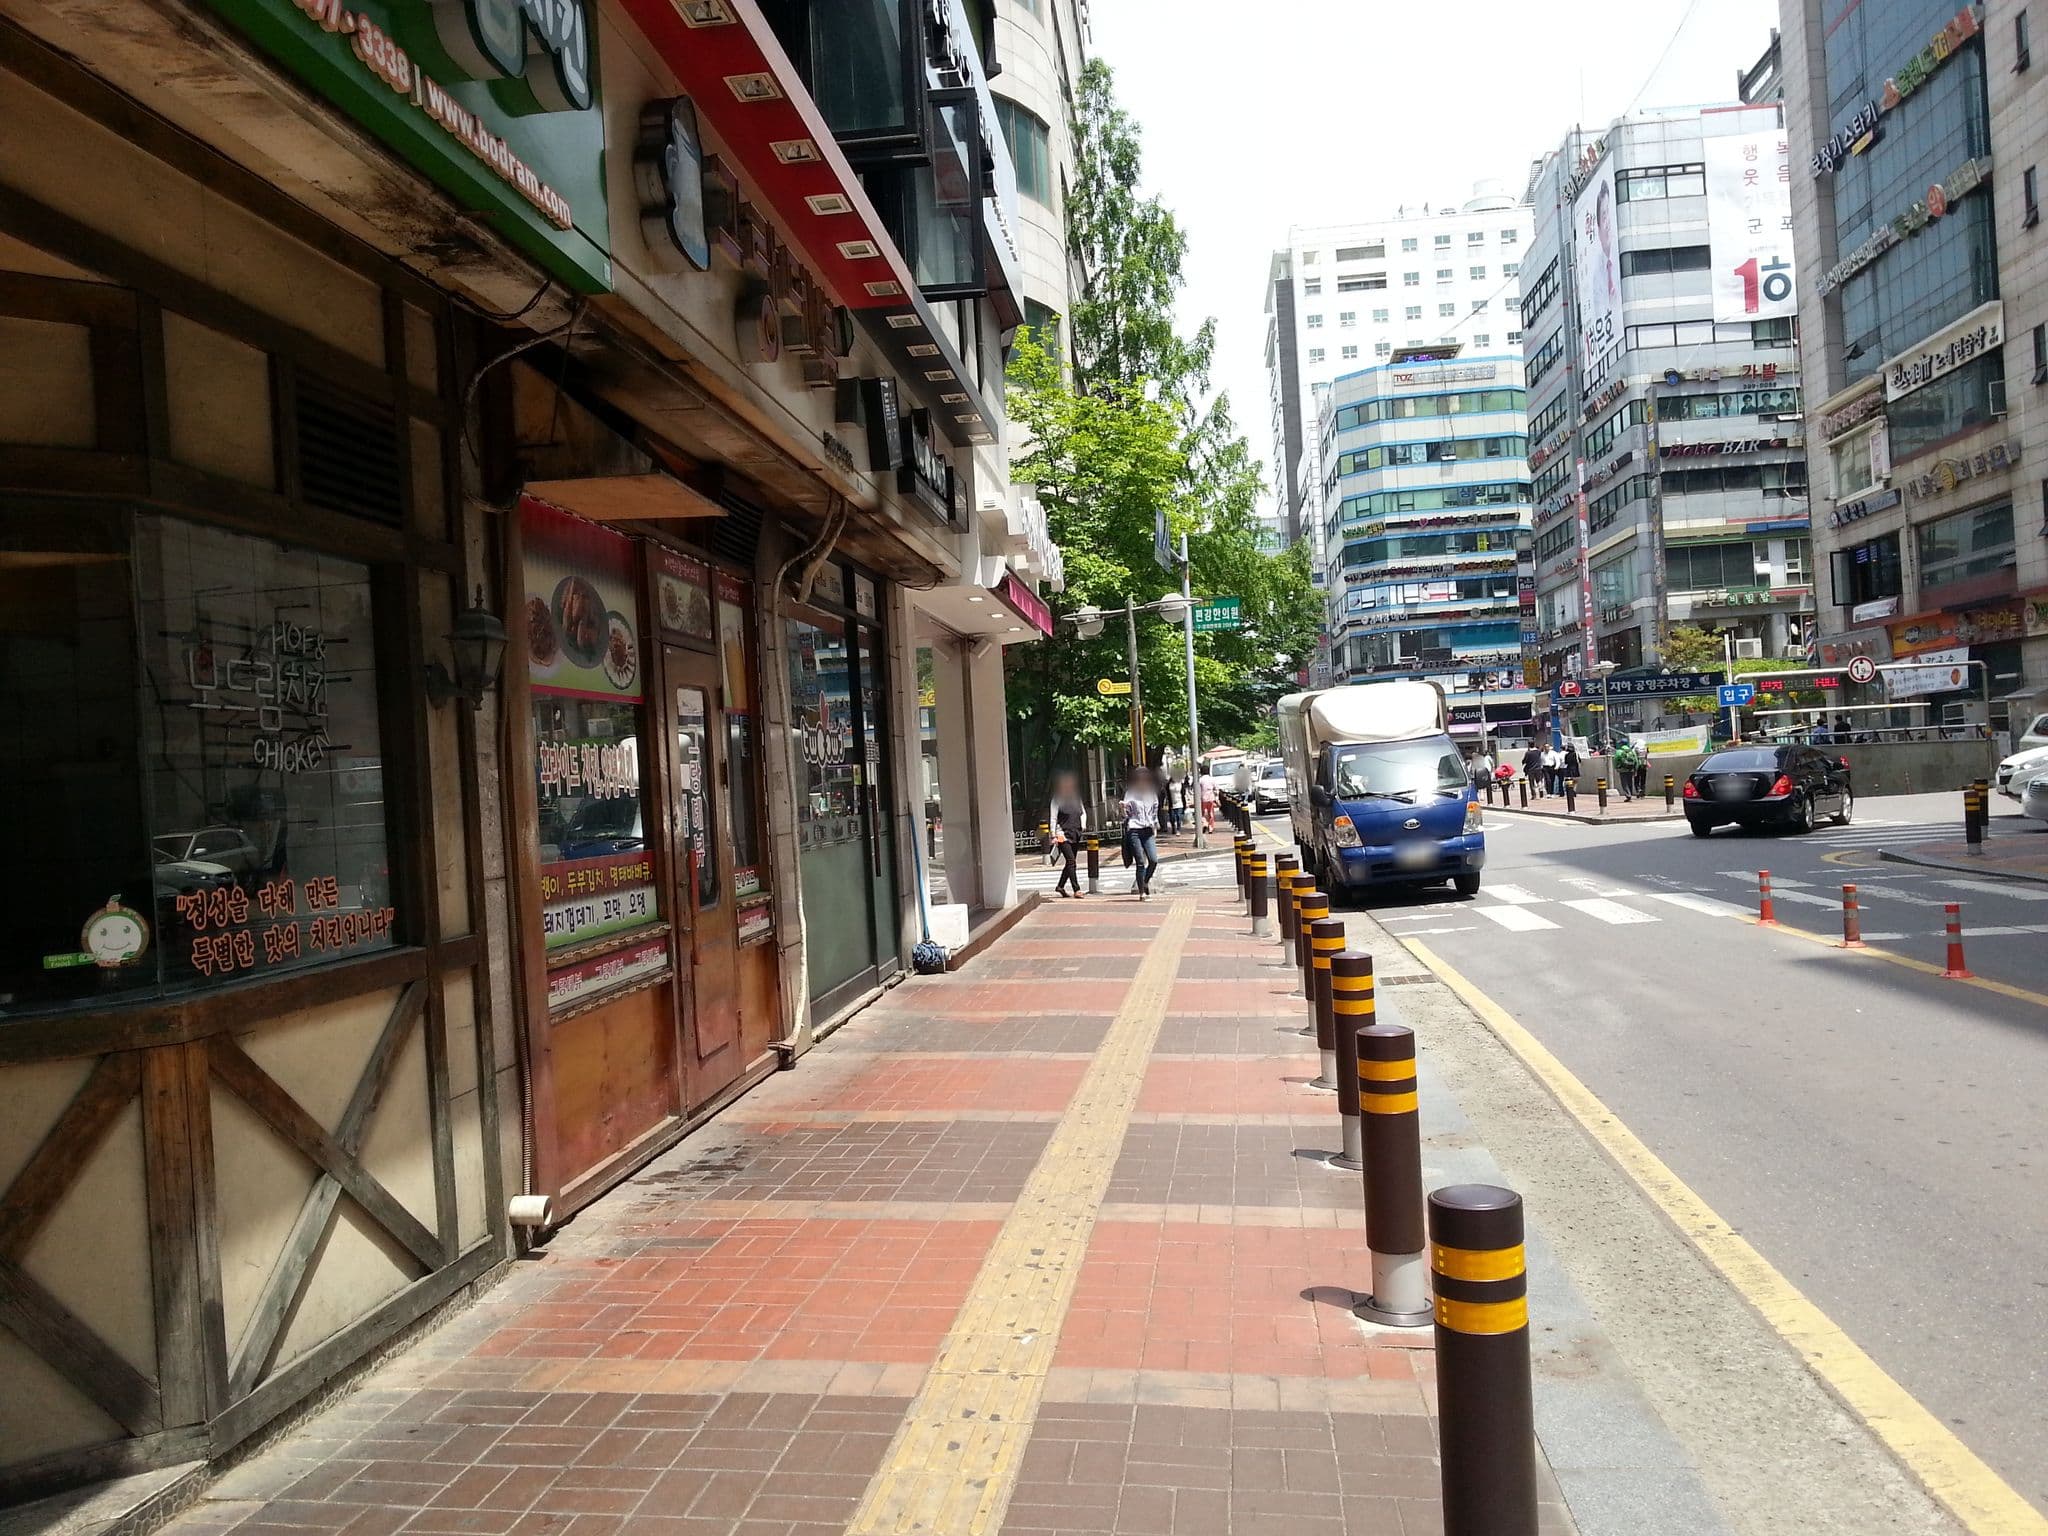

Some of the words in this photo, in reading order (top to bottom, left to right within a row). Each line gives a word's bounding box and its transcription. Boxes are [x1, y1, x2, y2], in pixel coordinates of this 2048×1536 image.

[424, 77, 572, 228] www.bodram.com
[1811, 136, 1843, 178] 보청기
[1844, 101, 1878, 143] 스타키
[1936, 326, 1986, 371] 노래연습장
[1742, 363, 1778, 380] 가발
[1721, 439, 1760, 454] BAR
[1728, 590, 1771, 607] 비빔밥
[1194, 606, 1240, 623] 편강한의원
[1610, 680, 1632, 692] 지하
[1635, 677, 1692, 691] 공영주차장
[1724, 690, 1750, 703] 입구
[1454, 711, 1483, 720] SQUAR
[253, 727, 331, 775] CHICKEN
[568, 868, 607, 895] 두부김치,
[259, 879, 295, 919] 다해
[305, 876, 339, 911] 만든
[604, 896, 625, 920] 꼬막,
[629, 892, 646, 916] 오뎅
[192, 928, 254, 976] 특별한
[264, 920, 301, 963] 맛의
